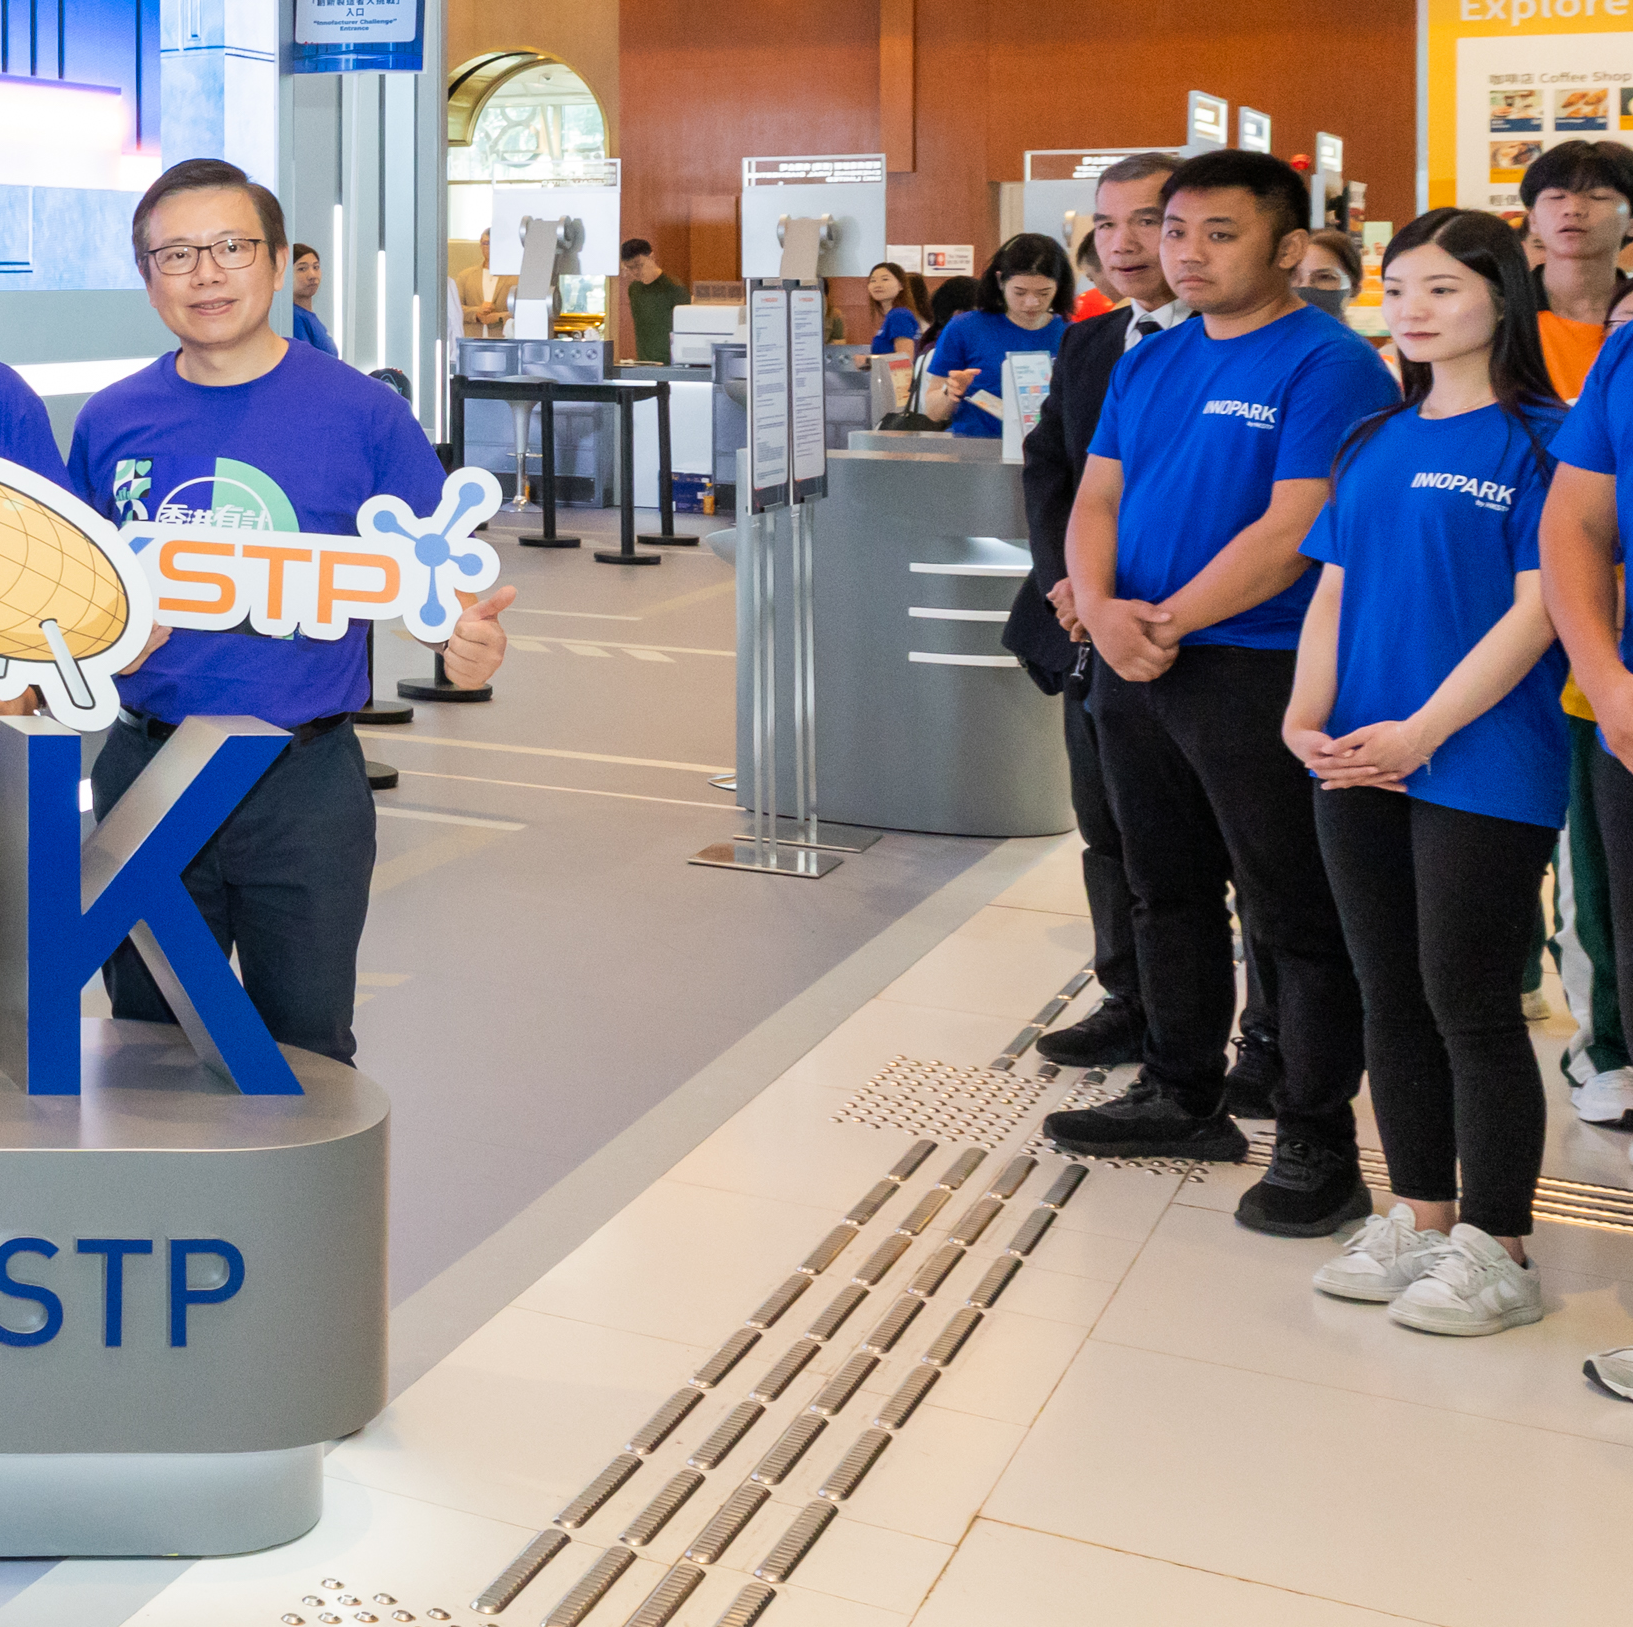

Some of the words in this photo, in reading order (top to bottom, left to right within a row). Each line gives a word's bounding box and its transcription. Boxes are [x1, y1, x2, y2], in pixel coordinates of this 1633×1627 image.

[346, 8, 364, 17] 入口
[1539, 72, 1588, 83] Coffee
[1593, 72, 1632, 83] Shop
[129, 537, 401, 624] STP
